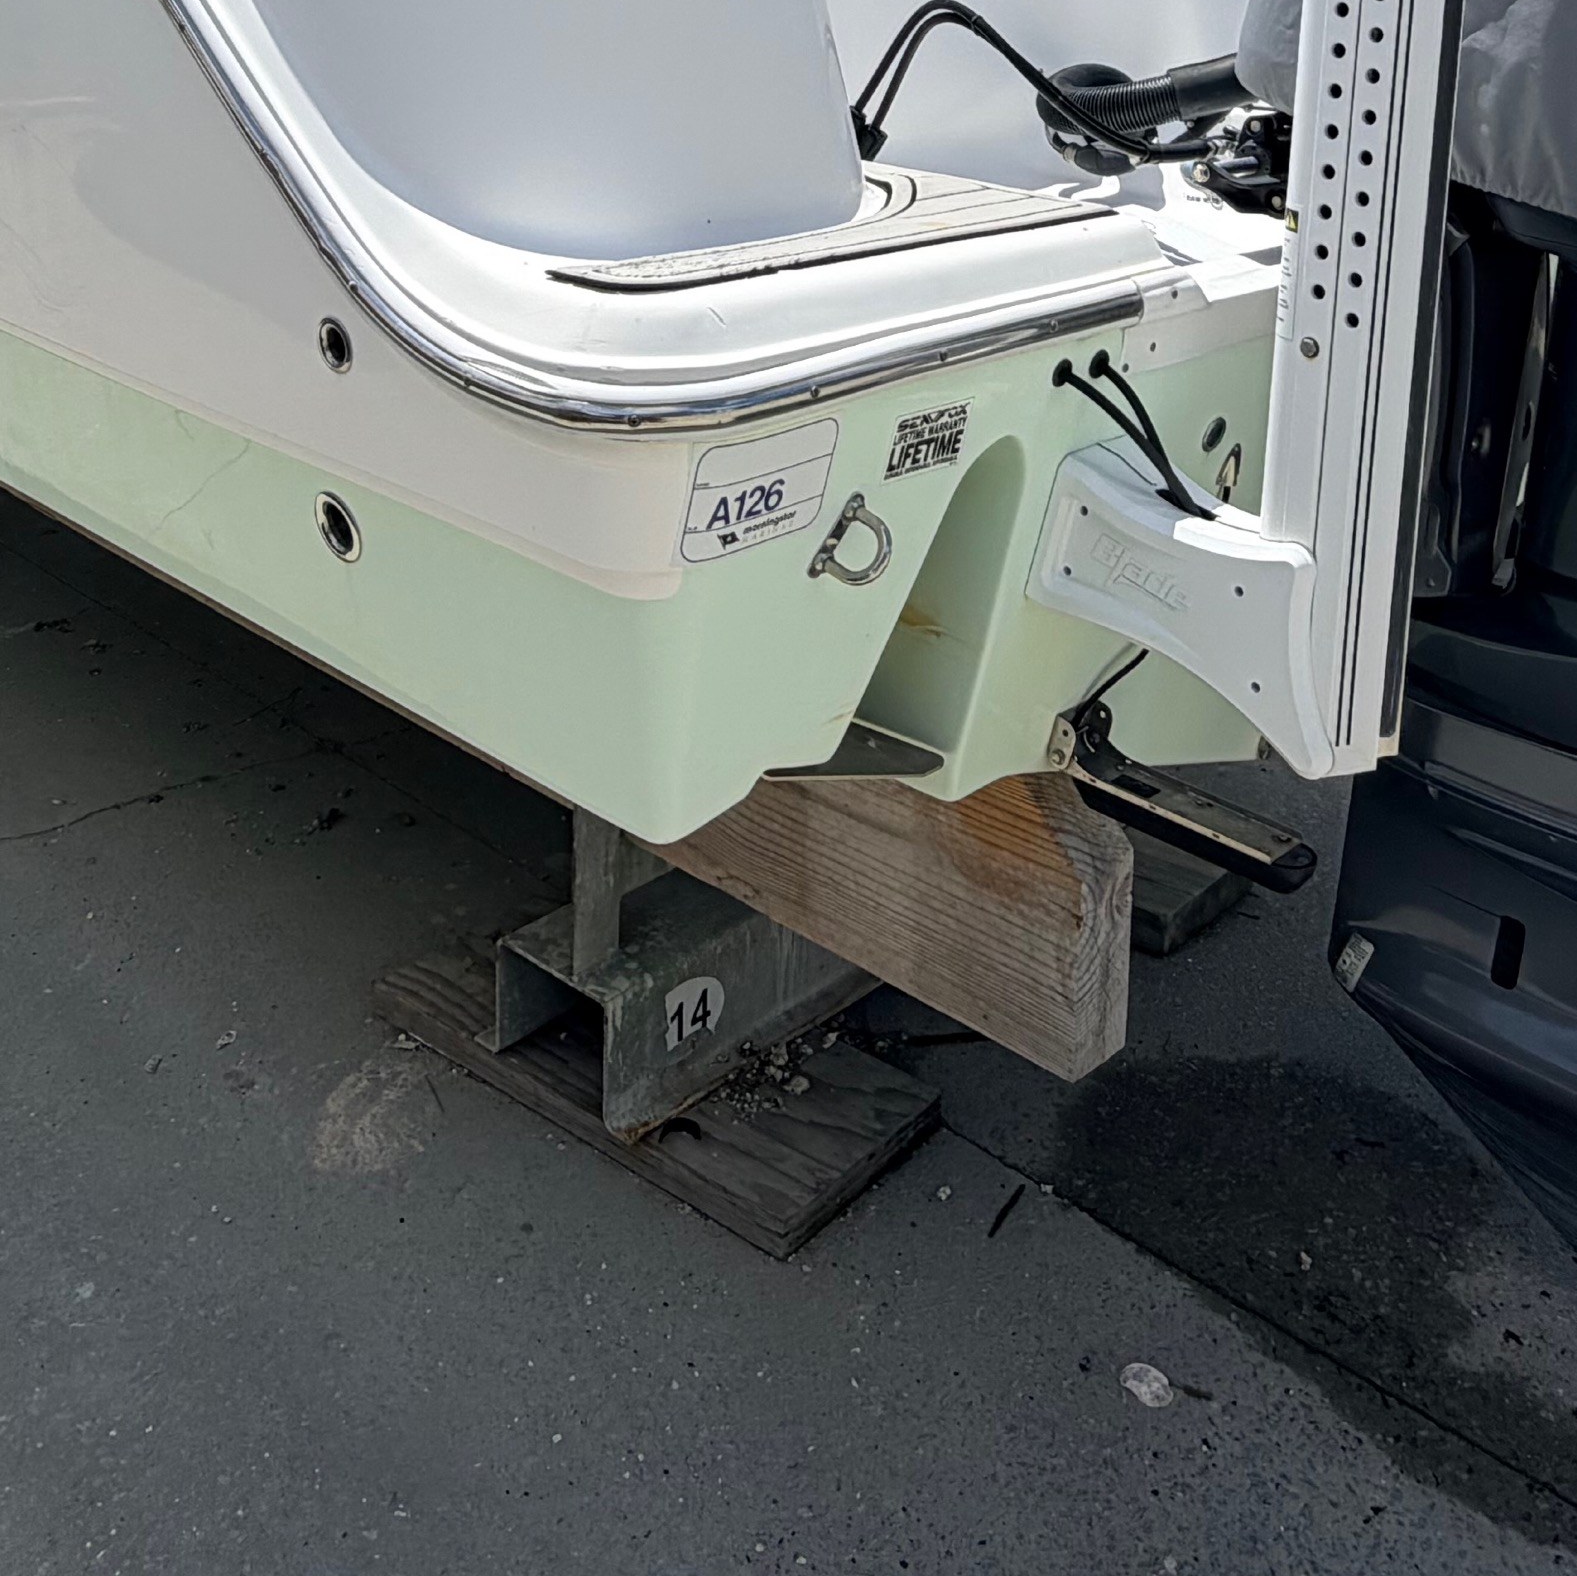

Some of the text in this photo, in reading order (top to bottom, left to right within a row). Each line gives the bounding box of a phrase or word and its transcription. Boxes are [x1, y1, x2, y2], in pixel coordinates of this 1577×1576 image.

[886, 428, 965, 473] LIFETIME
[706, 478, 785, 530] A126
[670, 988, 711, 1042] 14
